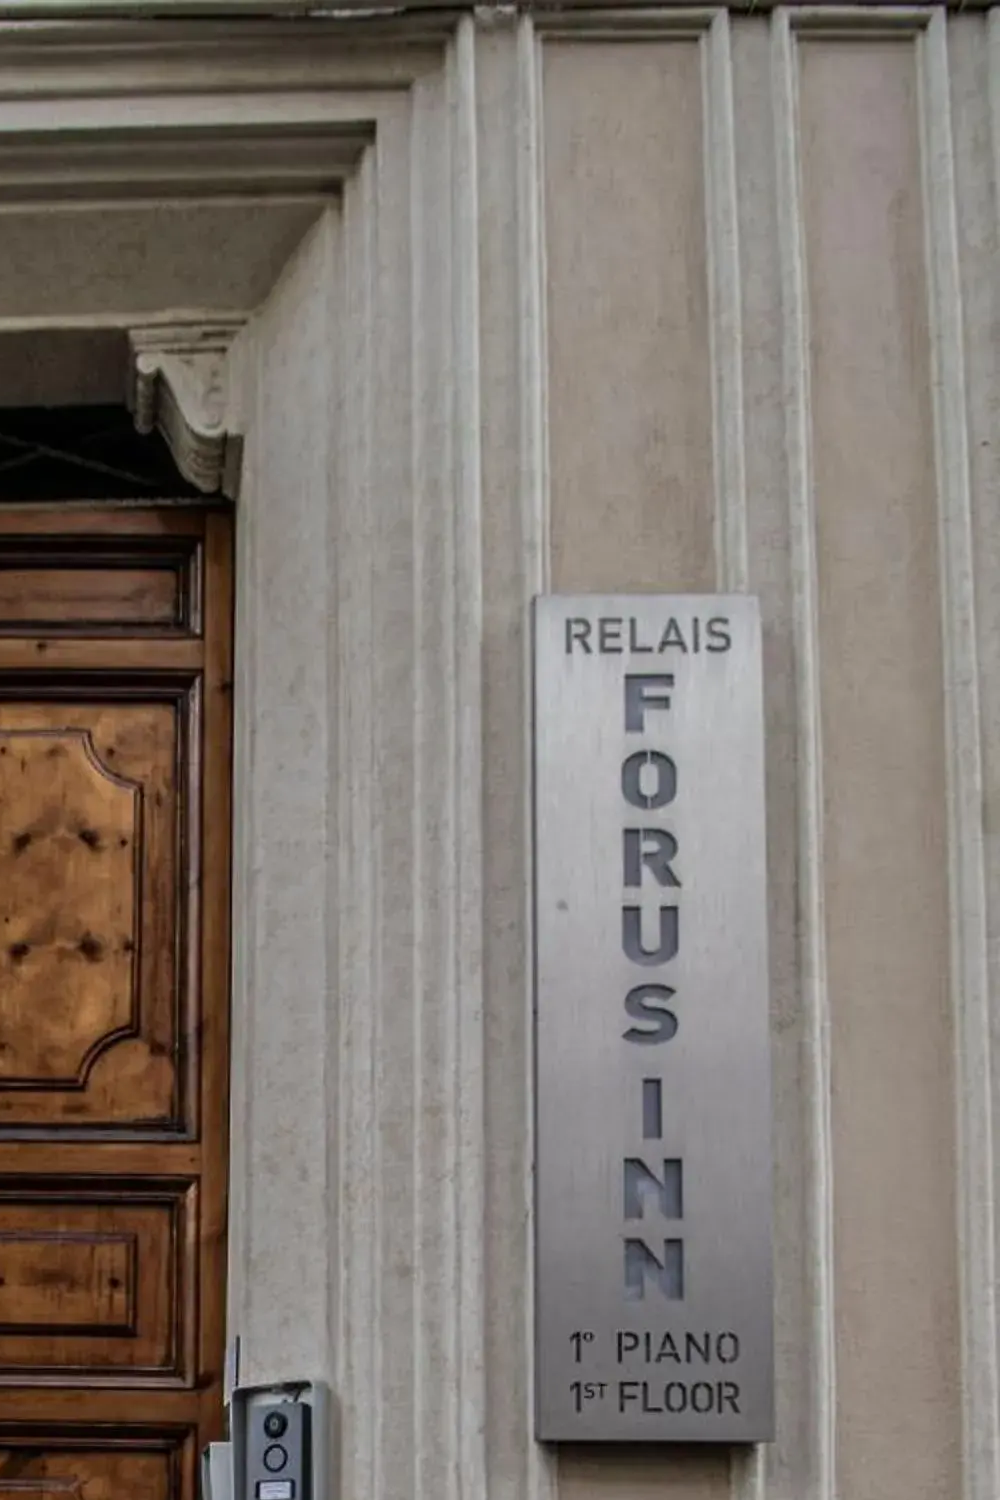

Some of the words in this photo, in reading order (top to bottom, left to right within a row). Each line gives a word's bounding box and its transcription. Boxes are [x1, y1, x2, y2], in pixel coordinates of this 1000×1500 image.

[565, 617, 732, 655] RELAIS
[621, 673, 681, 1045] FORUS
[623, 1078, 683, 1300] INN
[616, 1332, 740, 1365] PIANO
[569, 1381, 608, 1414] 1ST
[618, 1381, 741, 1414] FLOOR
